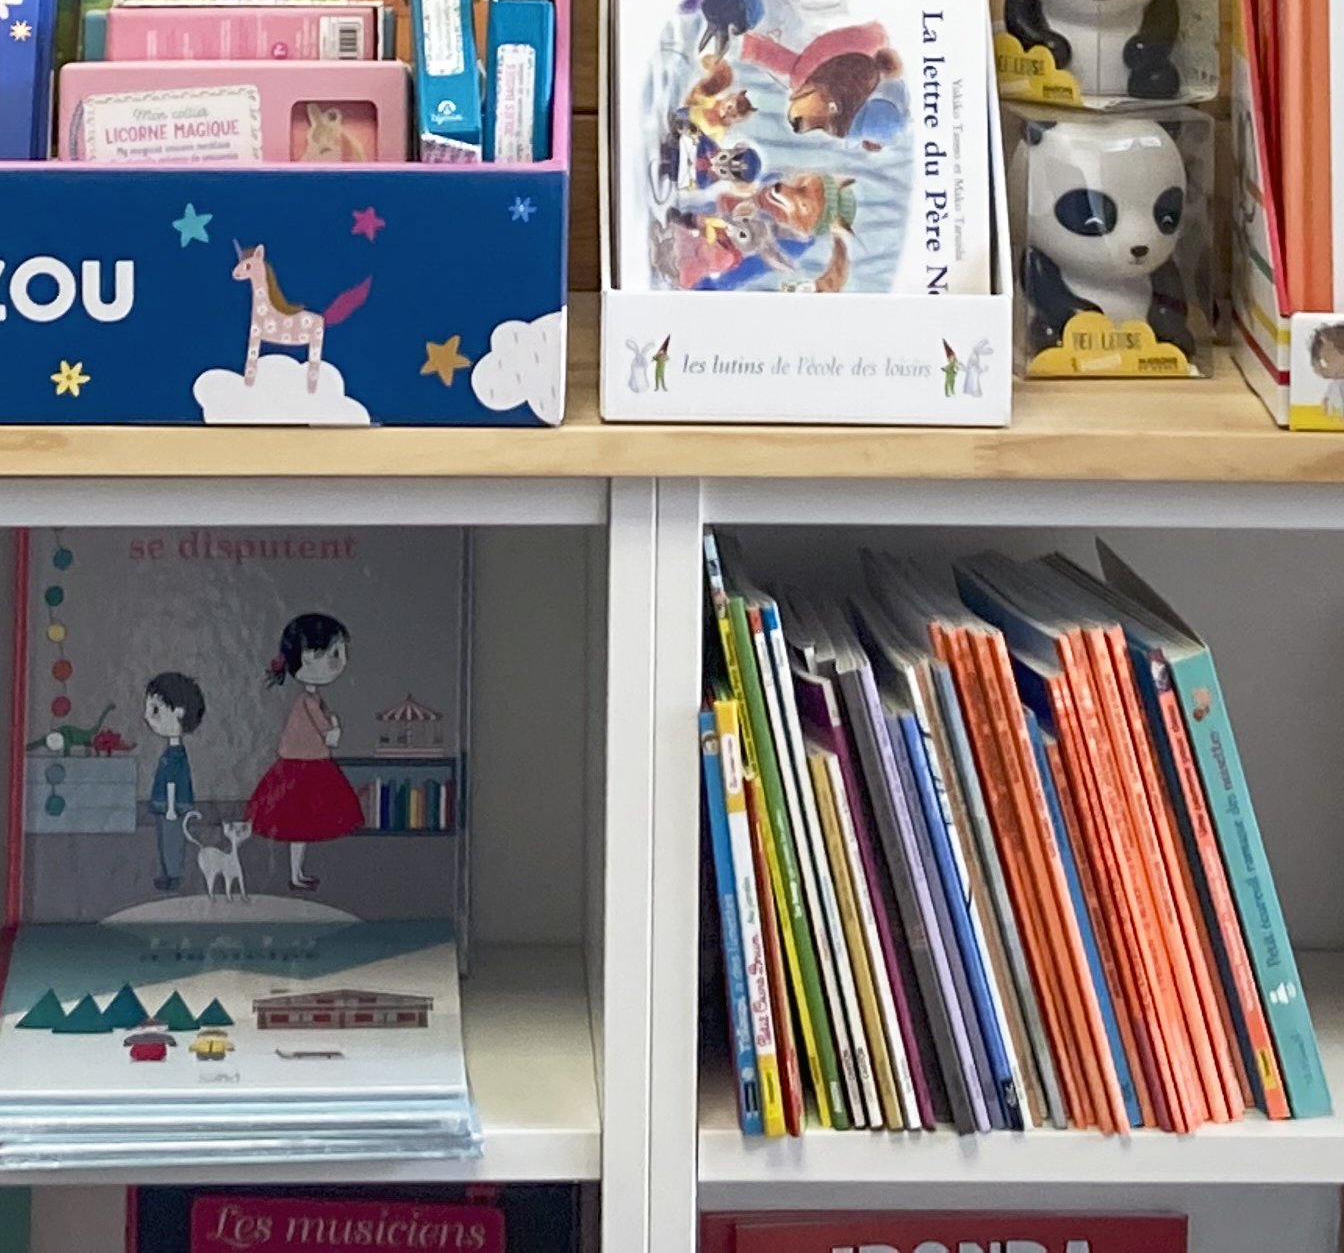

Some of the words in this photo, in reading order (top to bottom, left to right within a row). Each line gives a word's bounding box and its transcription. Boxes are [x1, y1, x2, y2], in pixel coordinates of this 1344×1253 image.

[921, 9, 945, 42] La
[923, 55, 947, 130] lettre
[105, 123, 167, 145] LICORNE
[174, 119, 240, 140] MAGIQUE
[924, 140, 948, 177] du
[924, 188, 949, 253] Père
[682, 353, 707, 375] les
[712, 353, 765, 376] lutins
[127, 534, 164, 561] se
[177, 529, 358, 565] disputent
[1258, 932, 1281, 968] Petit
[208, 1204, 273, 1247] Les
[285, 1204, 487, 1250] musiciens
